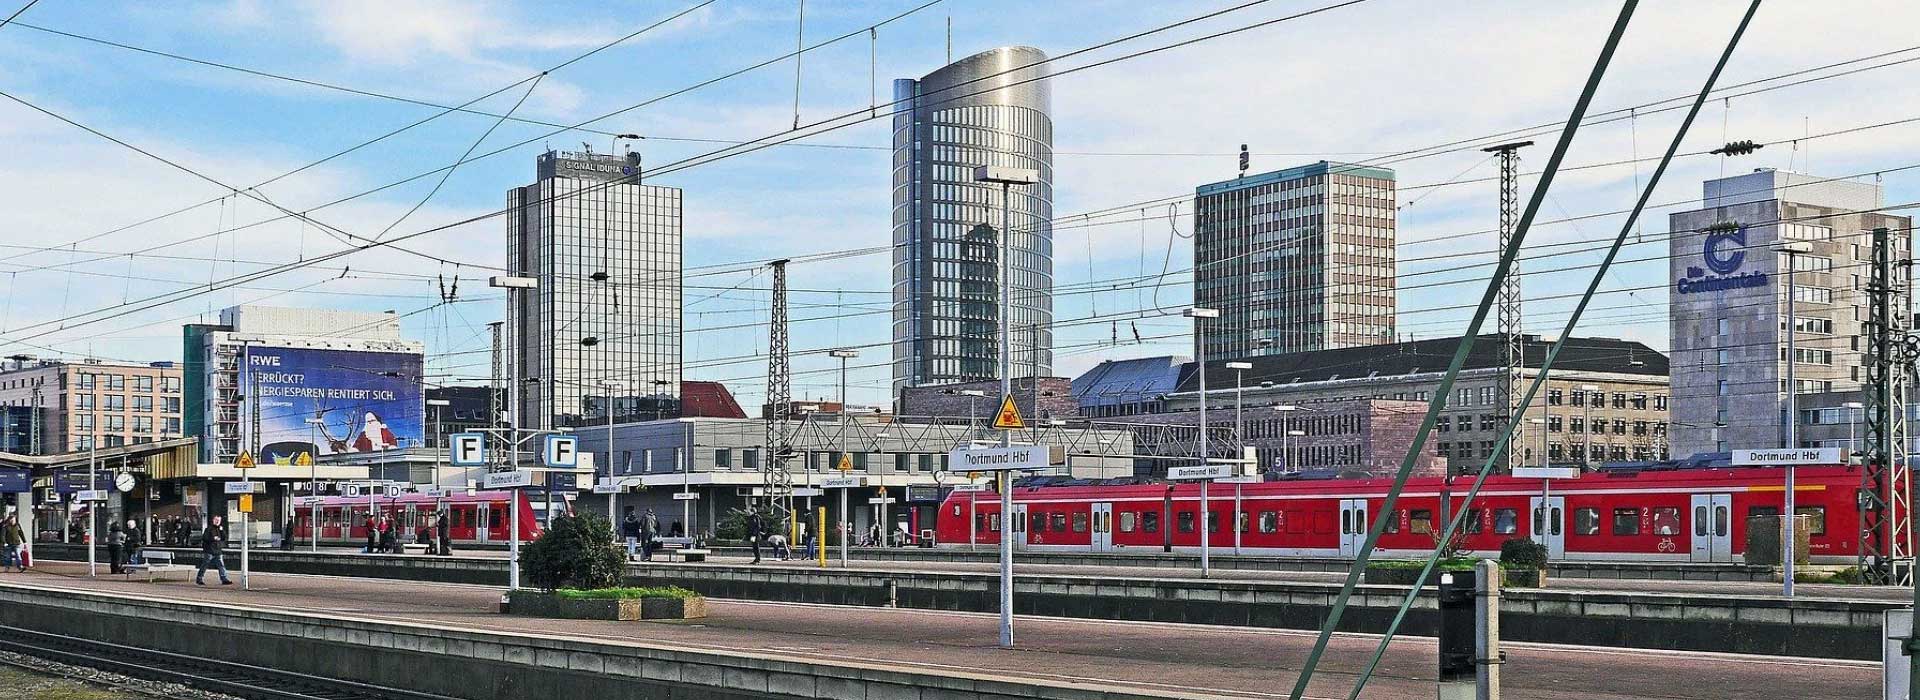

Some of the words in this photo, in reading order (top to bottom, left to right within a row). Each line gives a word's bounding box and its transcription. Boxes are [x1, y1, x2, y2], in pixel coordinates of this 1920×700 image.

[251, 355, 281, 366] RWE
[251, 386, 325, 398] NERGIESPAREN
[328, 389, 370, 400] RENTIERT
[372, 390, 396, 401] SICH.
[462, 438, 477, 460] F
[557, 440, 571, 462] F
[964, 452, 1009, 465] Dortmund
[1012, 450, 1030, 463] Hbf
[1750, 451, 1798, 461] Dortmund
[1802, 451, 1820, 460] Hbf
[1275, 458, 1282, 467] 5
[1178, 468, 1206, 477] Dortmund
[303, 481, 313, 491] 10
[350, 485, 358, 495] D
[391, 486, 399, 496] D
[1485, 508, 1491, 517] 2
[1642, 507, 1648, 517] 2
